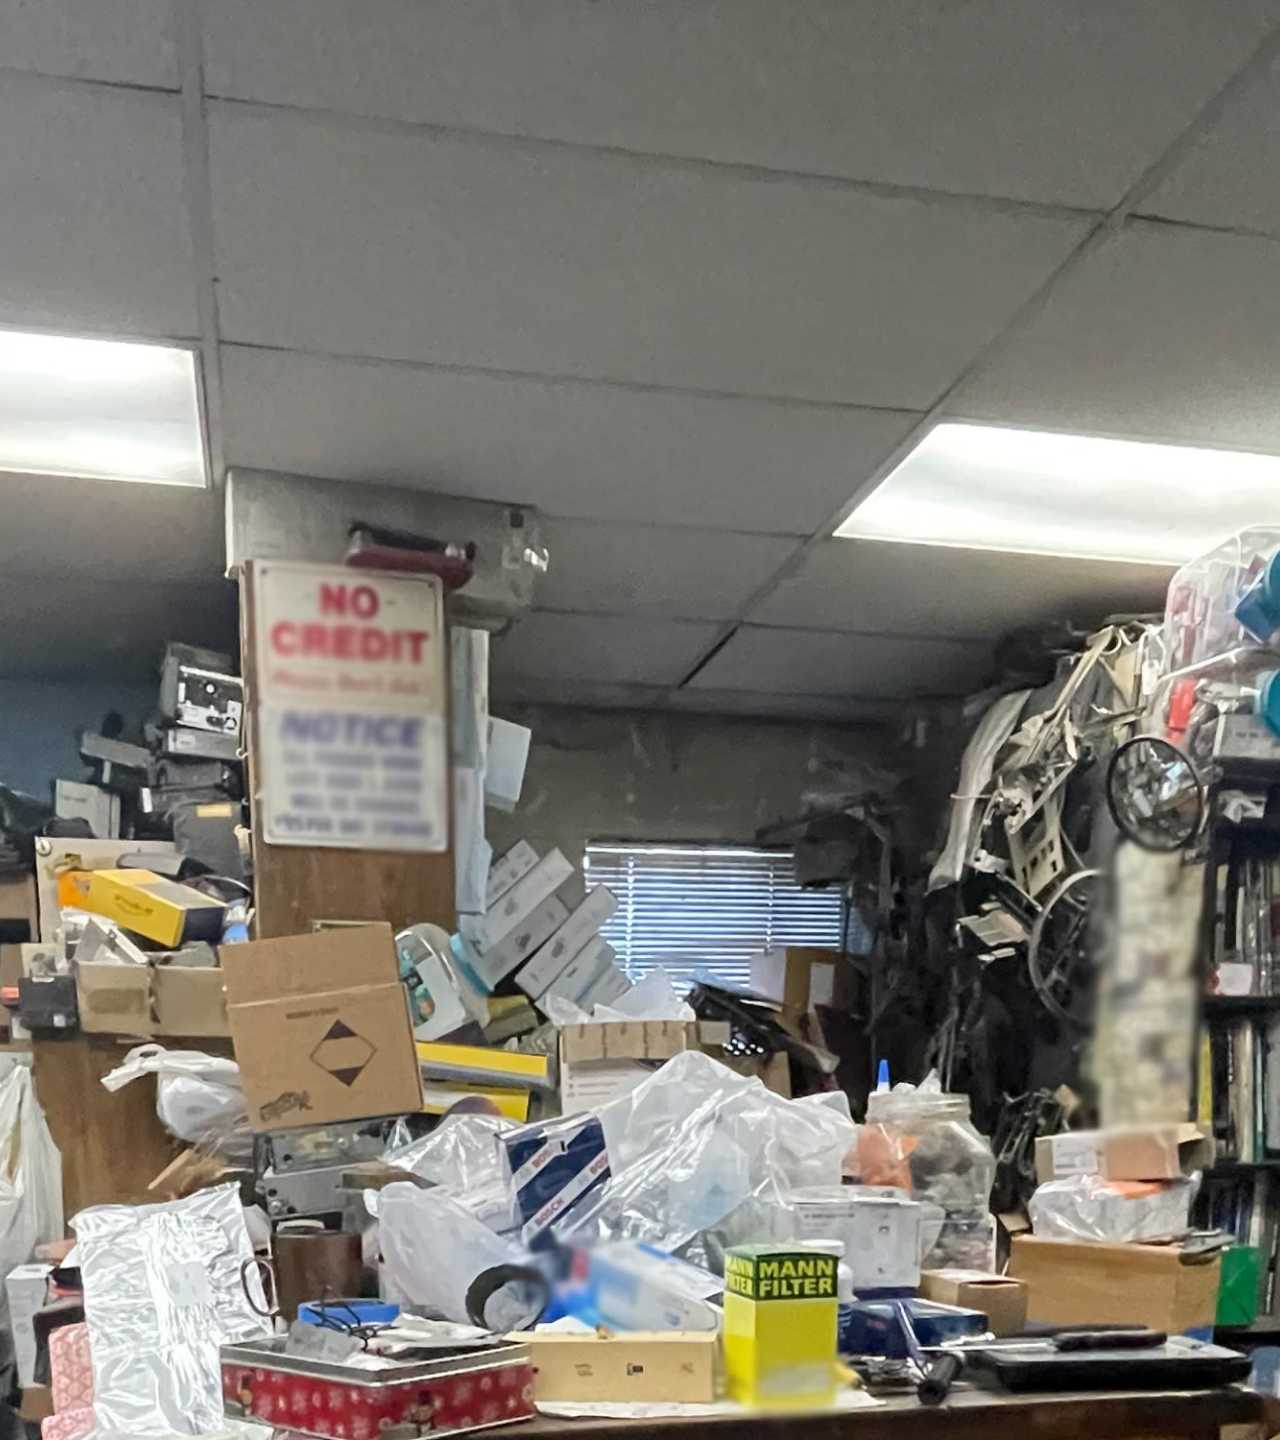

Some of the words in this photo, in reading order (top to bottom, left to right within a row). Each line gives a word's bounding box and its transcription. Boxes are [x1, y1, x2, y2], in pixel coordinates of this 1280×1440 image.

[318, 583, 380, 619] NO
[270, 621, 429, 665] CREDIT
[279, 710, 426, 749] NOTICE
[759, 1260, 834, 1278] MANN
[759, 1278, 834, 1297] FILTER
